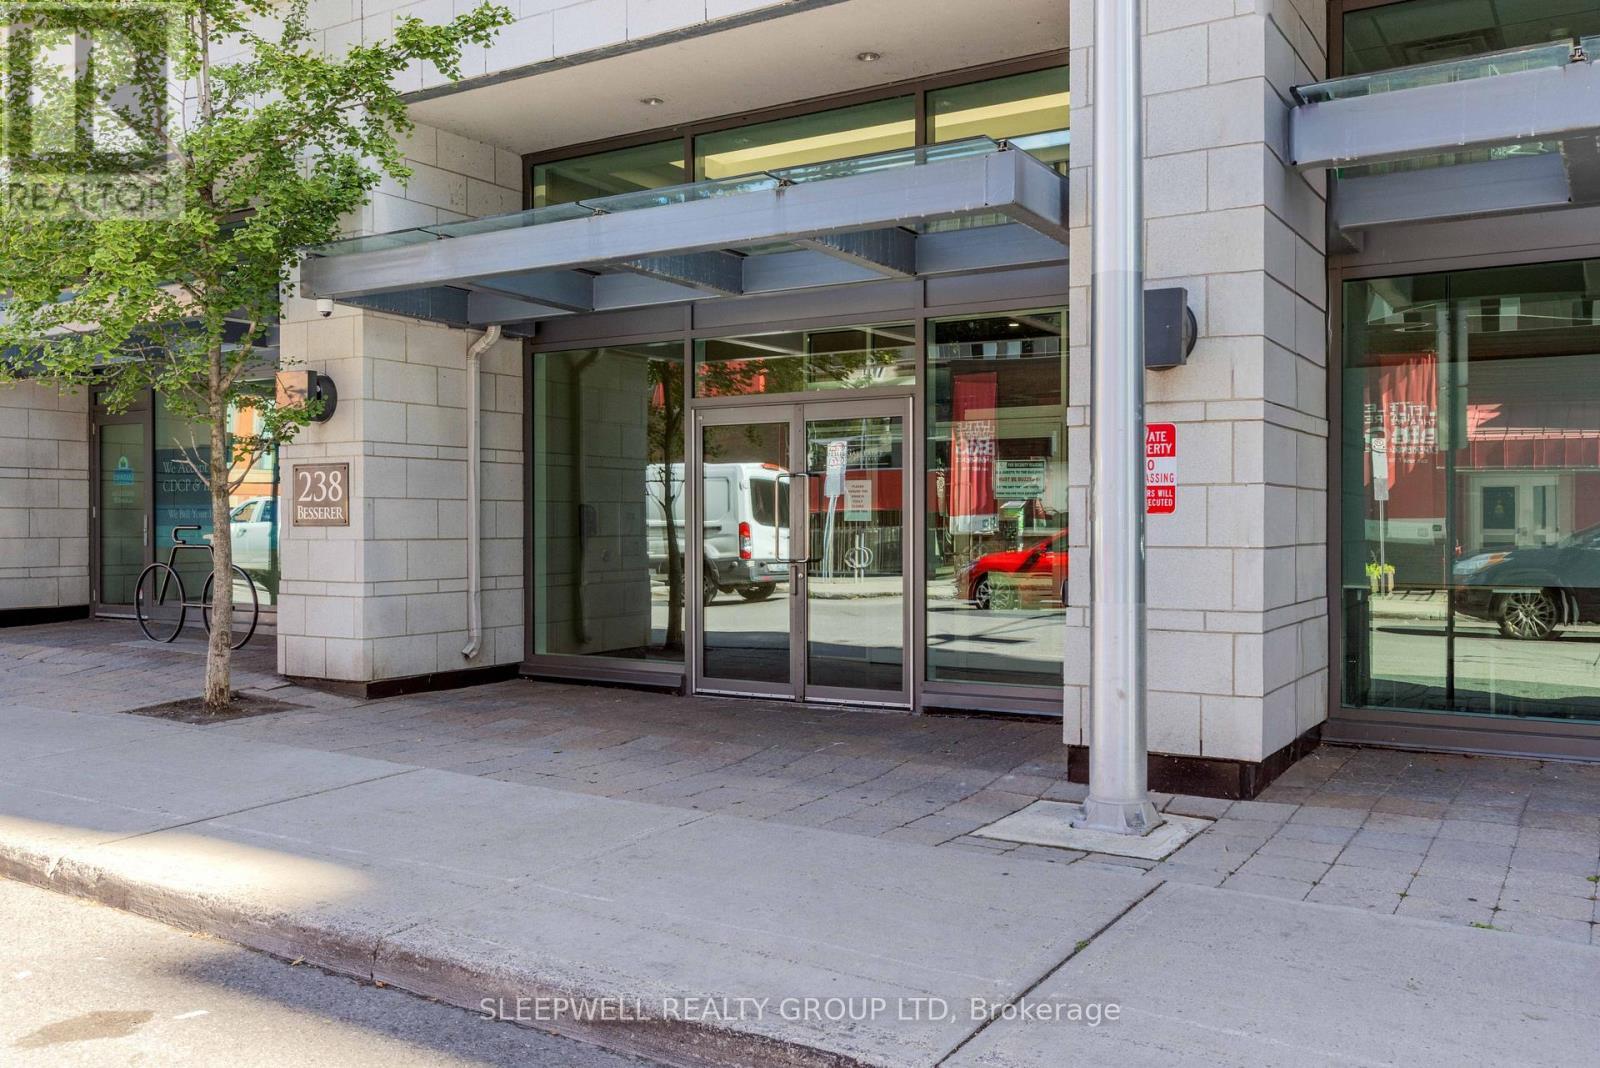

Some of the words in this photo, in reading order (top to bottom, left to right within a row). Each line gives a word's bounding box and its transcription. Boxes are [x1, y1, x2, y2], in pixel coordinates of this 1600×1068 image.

[1147, 459, 1155, 471] O
[298, 470, 342, 502] 238
[1157, 489, 1173, 497] WILL
[297, 505, 344, 520] BESSERER
